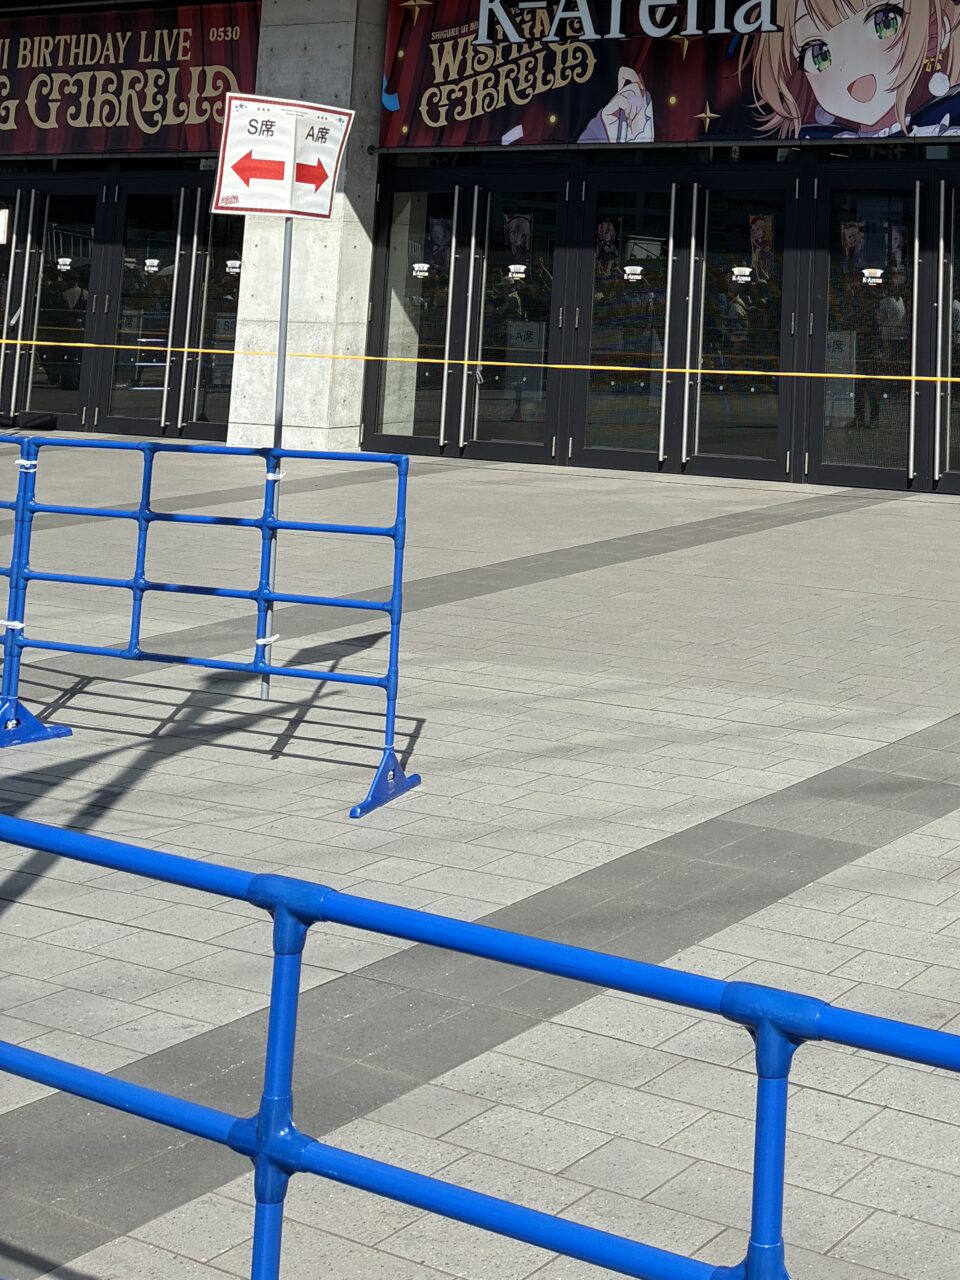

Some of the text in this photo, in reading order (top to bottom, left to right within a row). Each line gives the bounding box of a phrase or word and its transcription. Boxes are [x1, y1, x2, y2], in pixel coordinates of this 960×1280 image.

[209, 26, 240, 42] 0530
[17, 32, 132, 69] BIRTHDAY
[138, 27, 193, 63] LIVE
[247, 118, 277, 138] S席
[305, 125, 331, 144] A席
